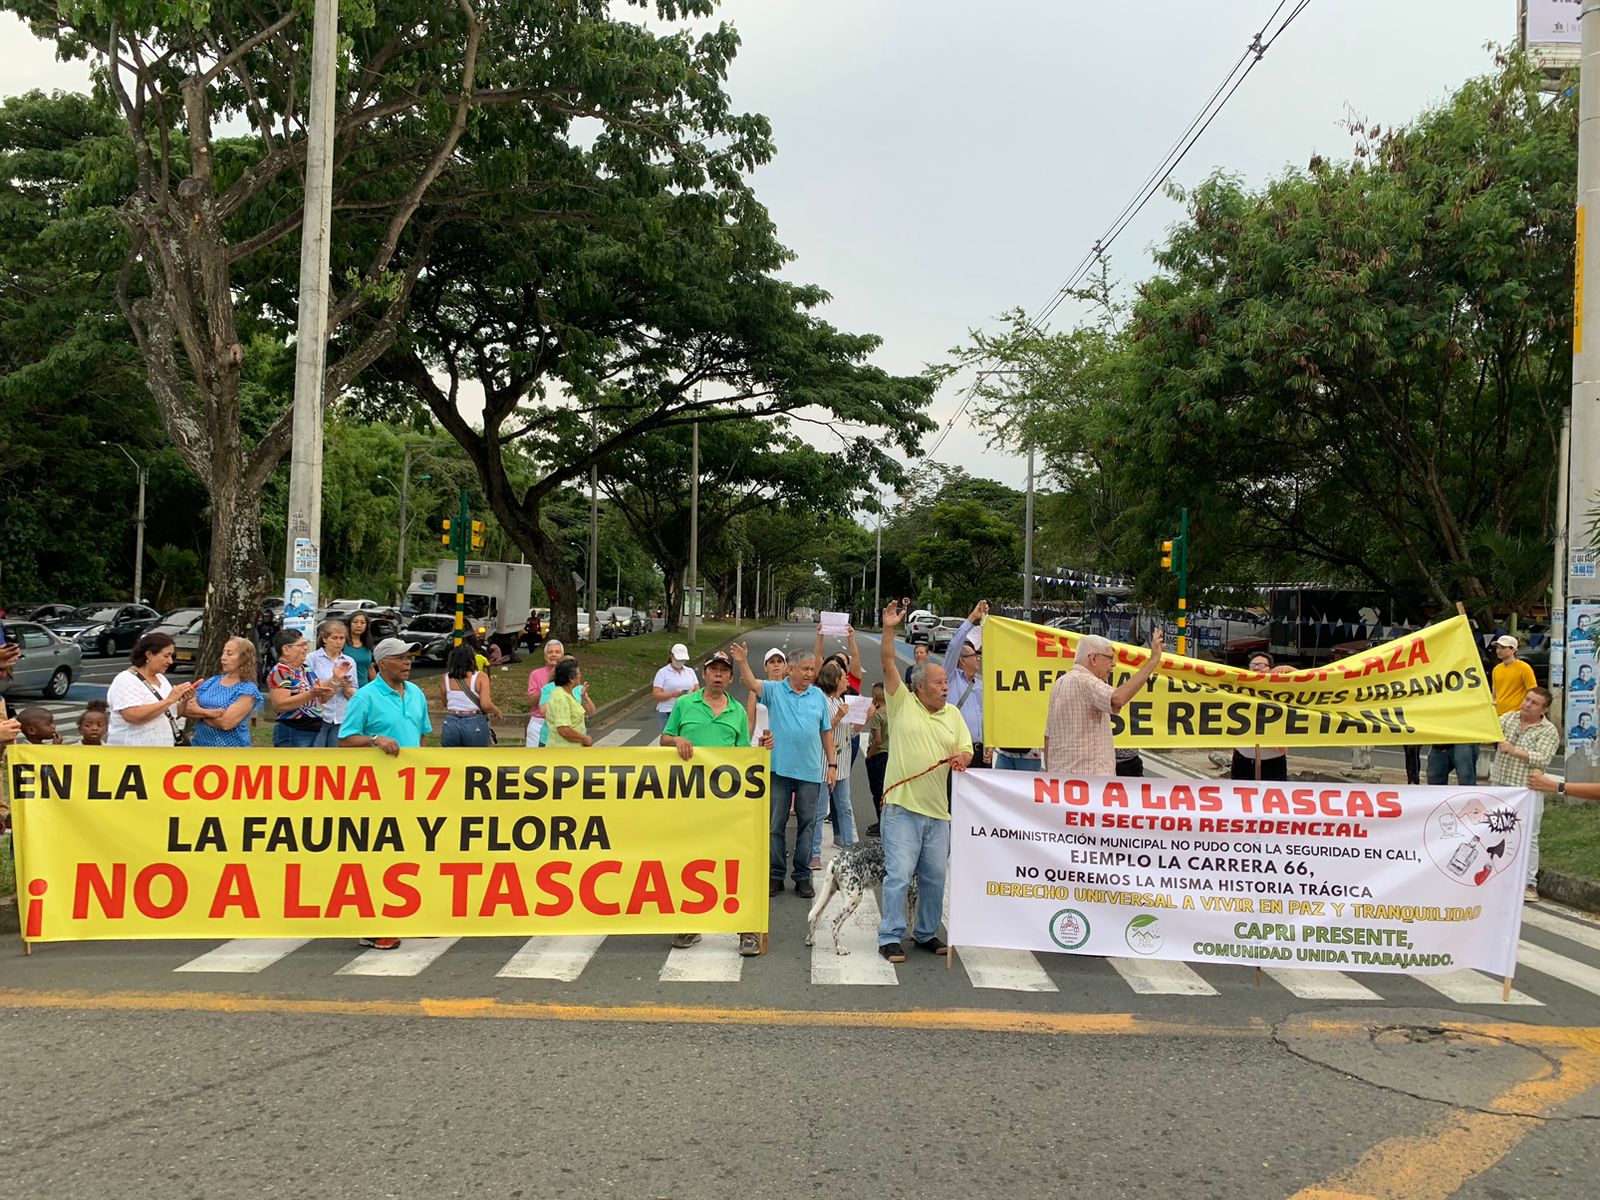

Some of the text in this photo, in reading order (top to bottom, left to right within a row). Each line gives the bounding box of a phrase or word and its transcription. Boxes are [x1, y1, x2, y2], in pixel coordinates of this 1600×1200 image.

[996, 670, 1030, 692] LA
[1145, 673, 1159, 693] Y
[1355, 667, 1482, 703] URBANOS
[12, 763, 766, 801] EN LA COMUNA 17 RESPETAMOS
[1034, 779, 1402, 818] NO A LAS TASCAS
[168, 815, 611, 852] LA FAUNA Y FLORA
[1065, 811, 1368, 838] EN SECTOR RESIDENCIAL
[971, 826, 1422, 863] LA ADMINISTRACIÓN MUNICIPAL NO PUDO CON LA SEGURIDAD EN CALI,
[1070, 849, 1315, 878] EJEMPLO LA CARRERA 66,
[209, 863, 261, 919] A
[284, 862, 422, 919] LAS
[440, 860, 740, 917] TASCAS!
[1016, 866, 1373, 898] NO QUEREMOS LA MISMA HISTORIA TRÁGICA
[986, 881, 1482, 924] DERECHO UNIVERSAL A VIVIR EN PAZ Y TRANQUILIDAD
[1234, 922, 1414, 949] CAPRI PRESENTE,
[1193, 942, 1454, 969] COMUNIDAD UNIDA TRABAJANDO.
